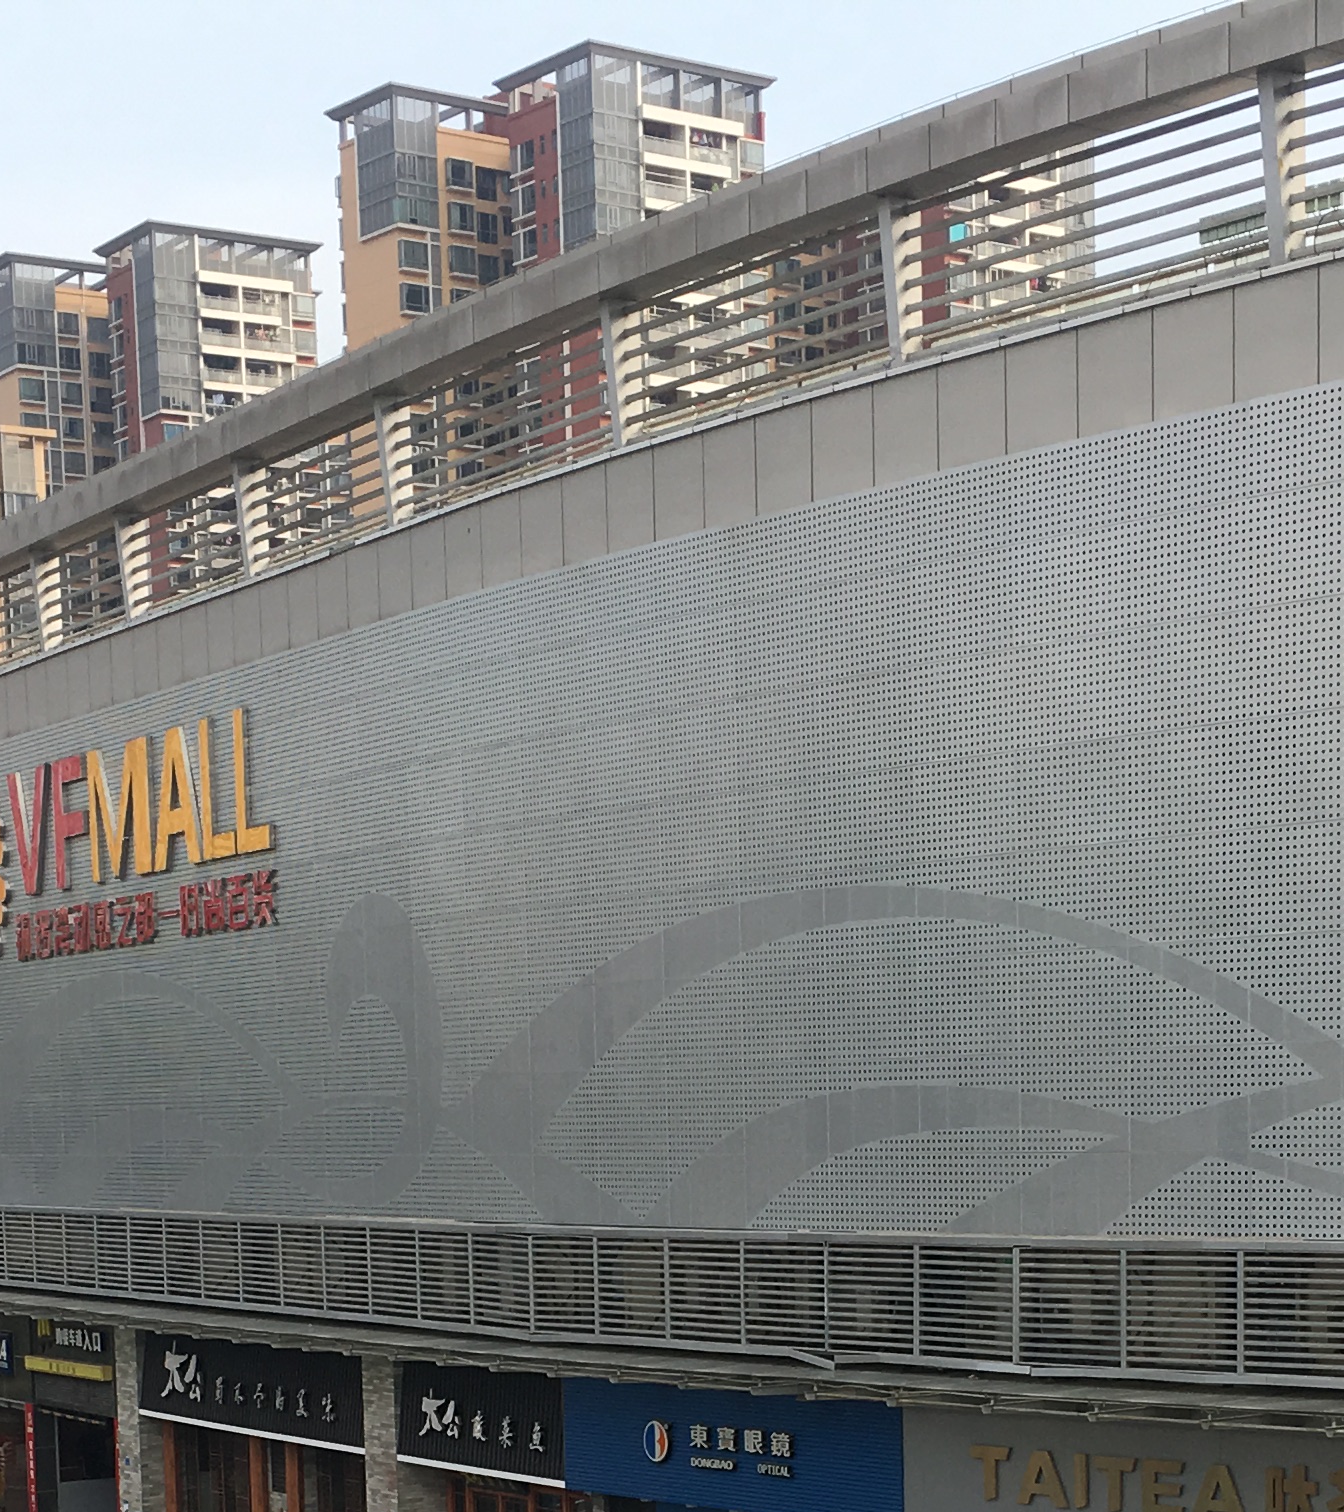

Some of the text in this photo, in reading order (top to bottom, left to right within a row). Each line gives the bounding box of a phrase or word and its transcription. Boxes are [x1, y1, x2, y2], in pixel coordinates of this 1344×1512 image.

[7, 708, 273, 895] VFMALL
[689, 1424, 792, 1457] 東寶眼鏡
[690, 1457, 791, 1477] DONGBAO OPTICAL
